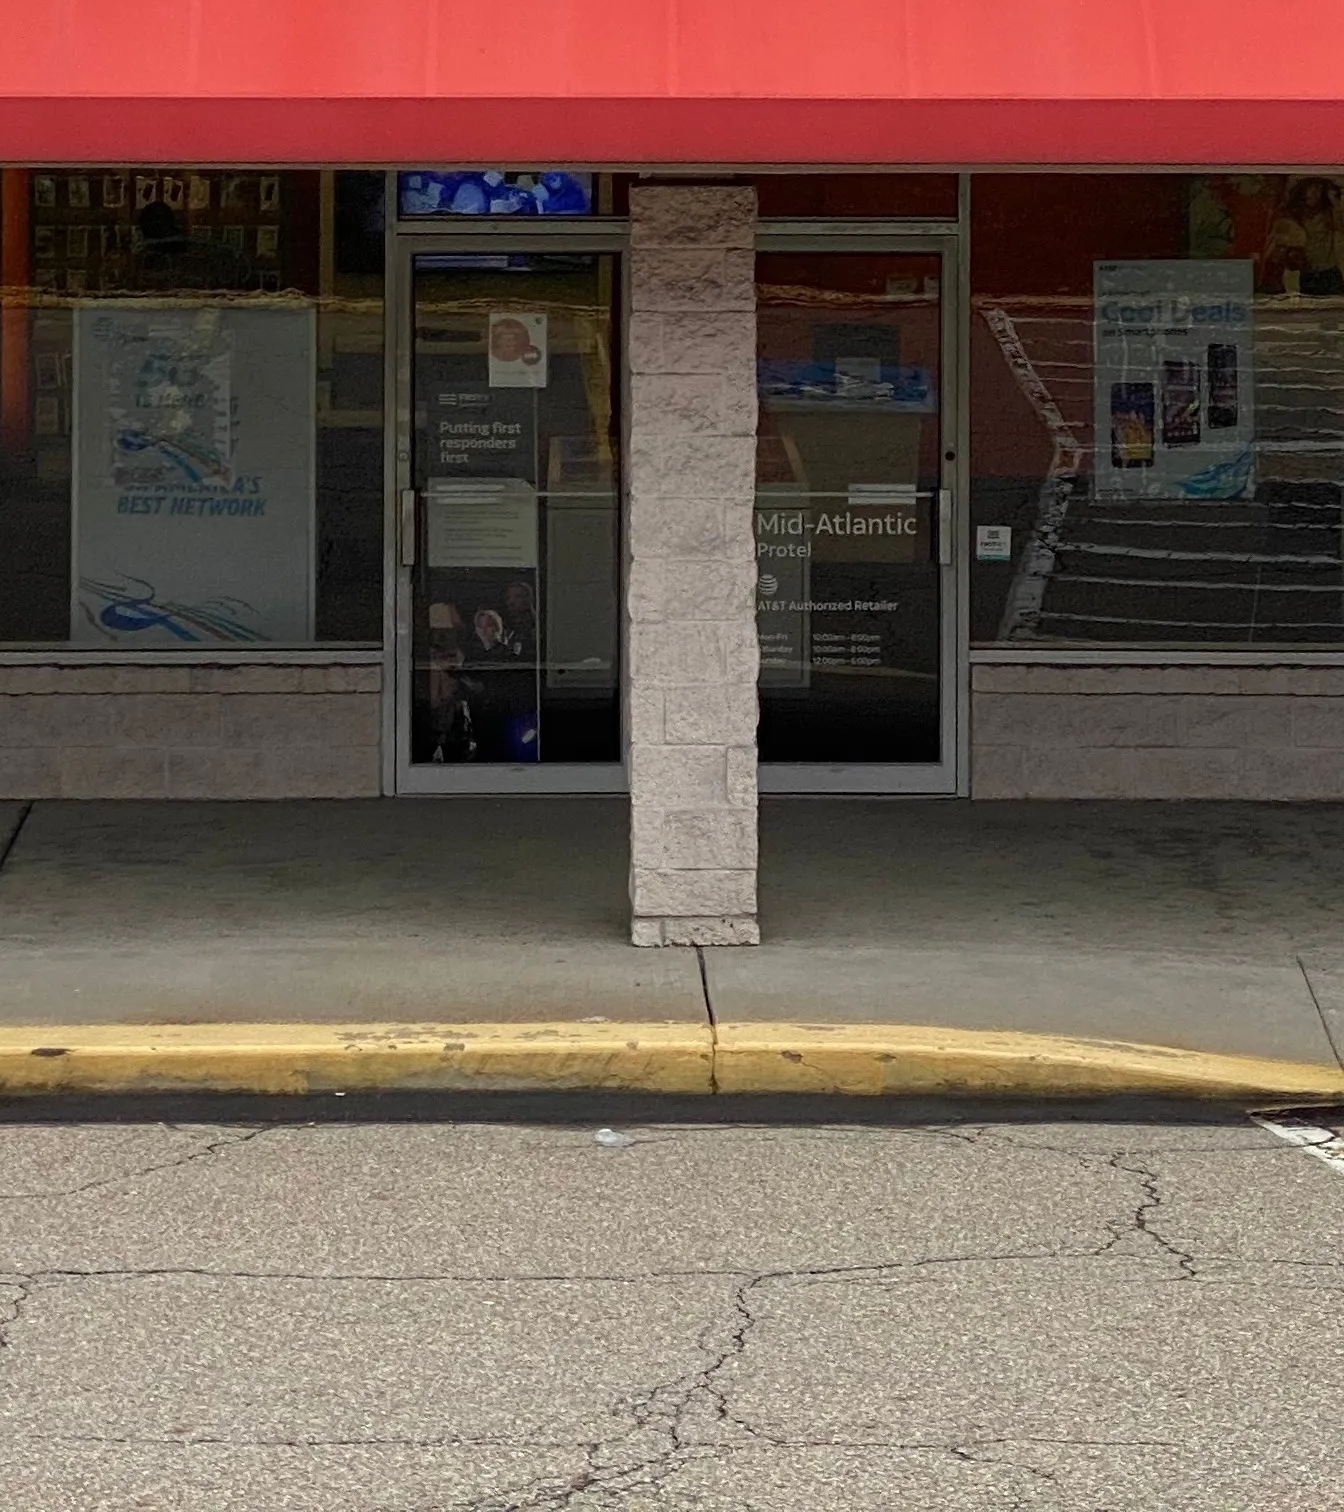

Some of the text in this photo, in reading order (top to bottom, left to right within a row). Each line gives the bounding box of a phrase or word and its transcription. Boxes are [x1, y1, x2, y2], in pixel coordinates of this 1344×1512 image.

[1171, 300, 1246, 322] Deals
[439, 421, 521, 435] Putting first
[440, 437, 516, 450] responders
[440, 451, 469, 463] first
[117, 496, 268, 517] BEST NETWORK
[757, 512, 917, 536] Mid-Atlantic
[757, 541, 811, 558] Protel
[758, 600, 898, 612] AT&T Authorized Retailer
